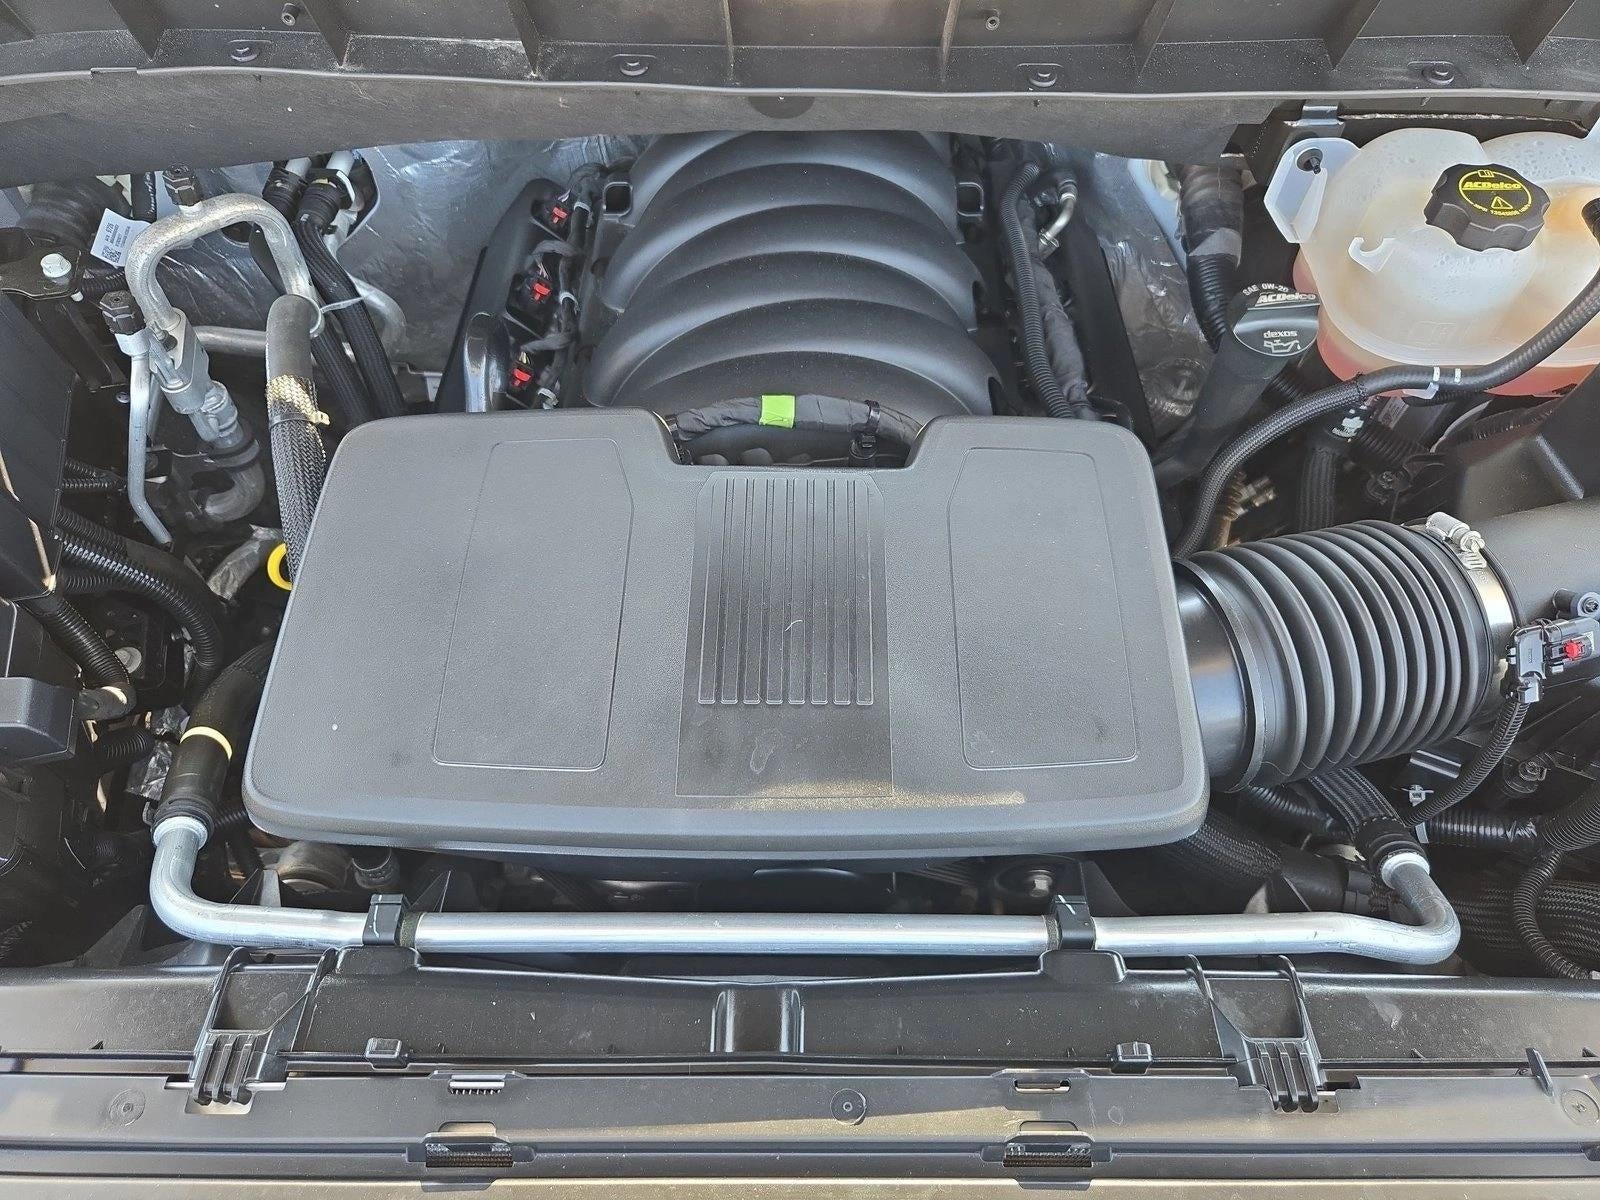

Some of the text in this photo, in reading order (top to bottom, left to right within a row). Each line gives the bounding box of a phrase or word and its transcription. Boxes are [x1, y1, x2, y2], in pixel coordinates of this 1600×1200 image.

[1463, 182, 1522, 190] ACDelco
[1242, 283, 1289, 296] SAE 0W-20
[1257, 292, 1316, 304] ACDelco
[1263, 330, 1298, 338] dexos
